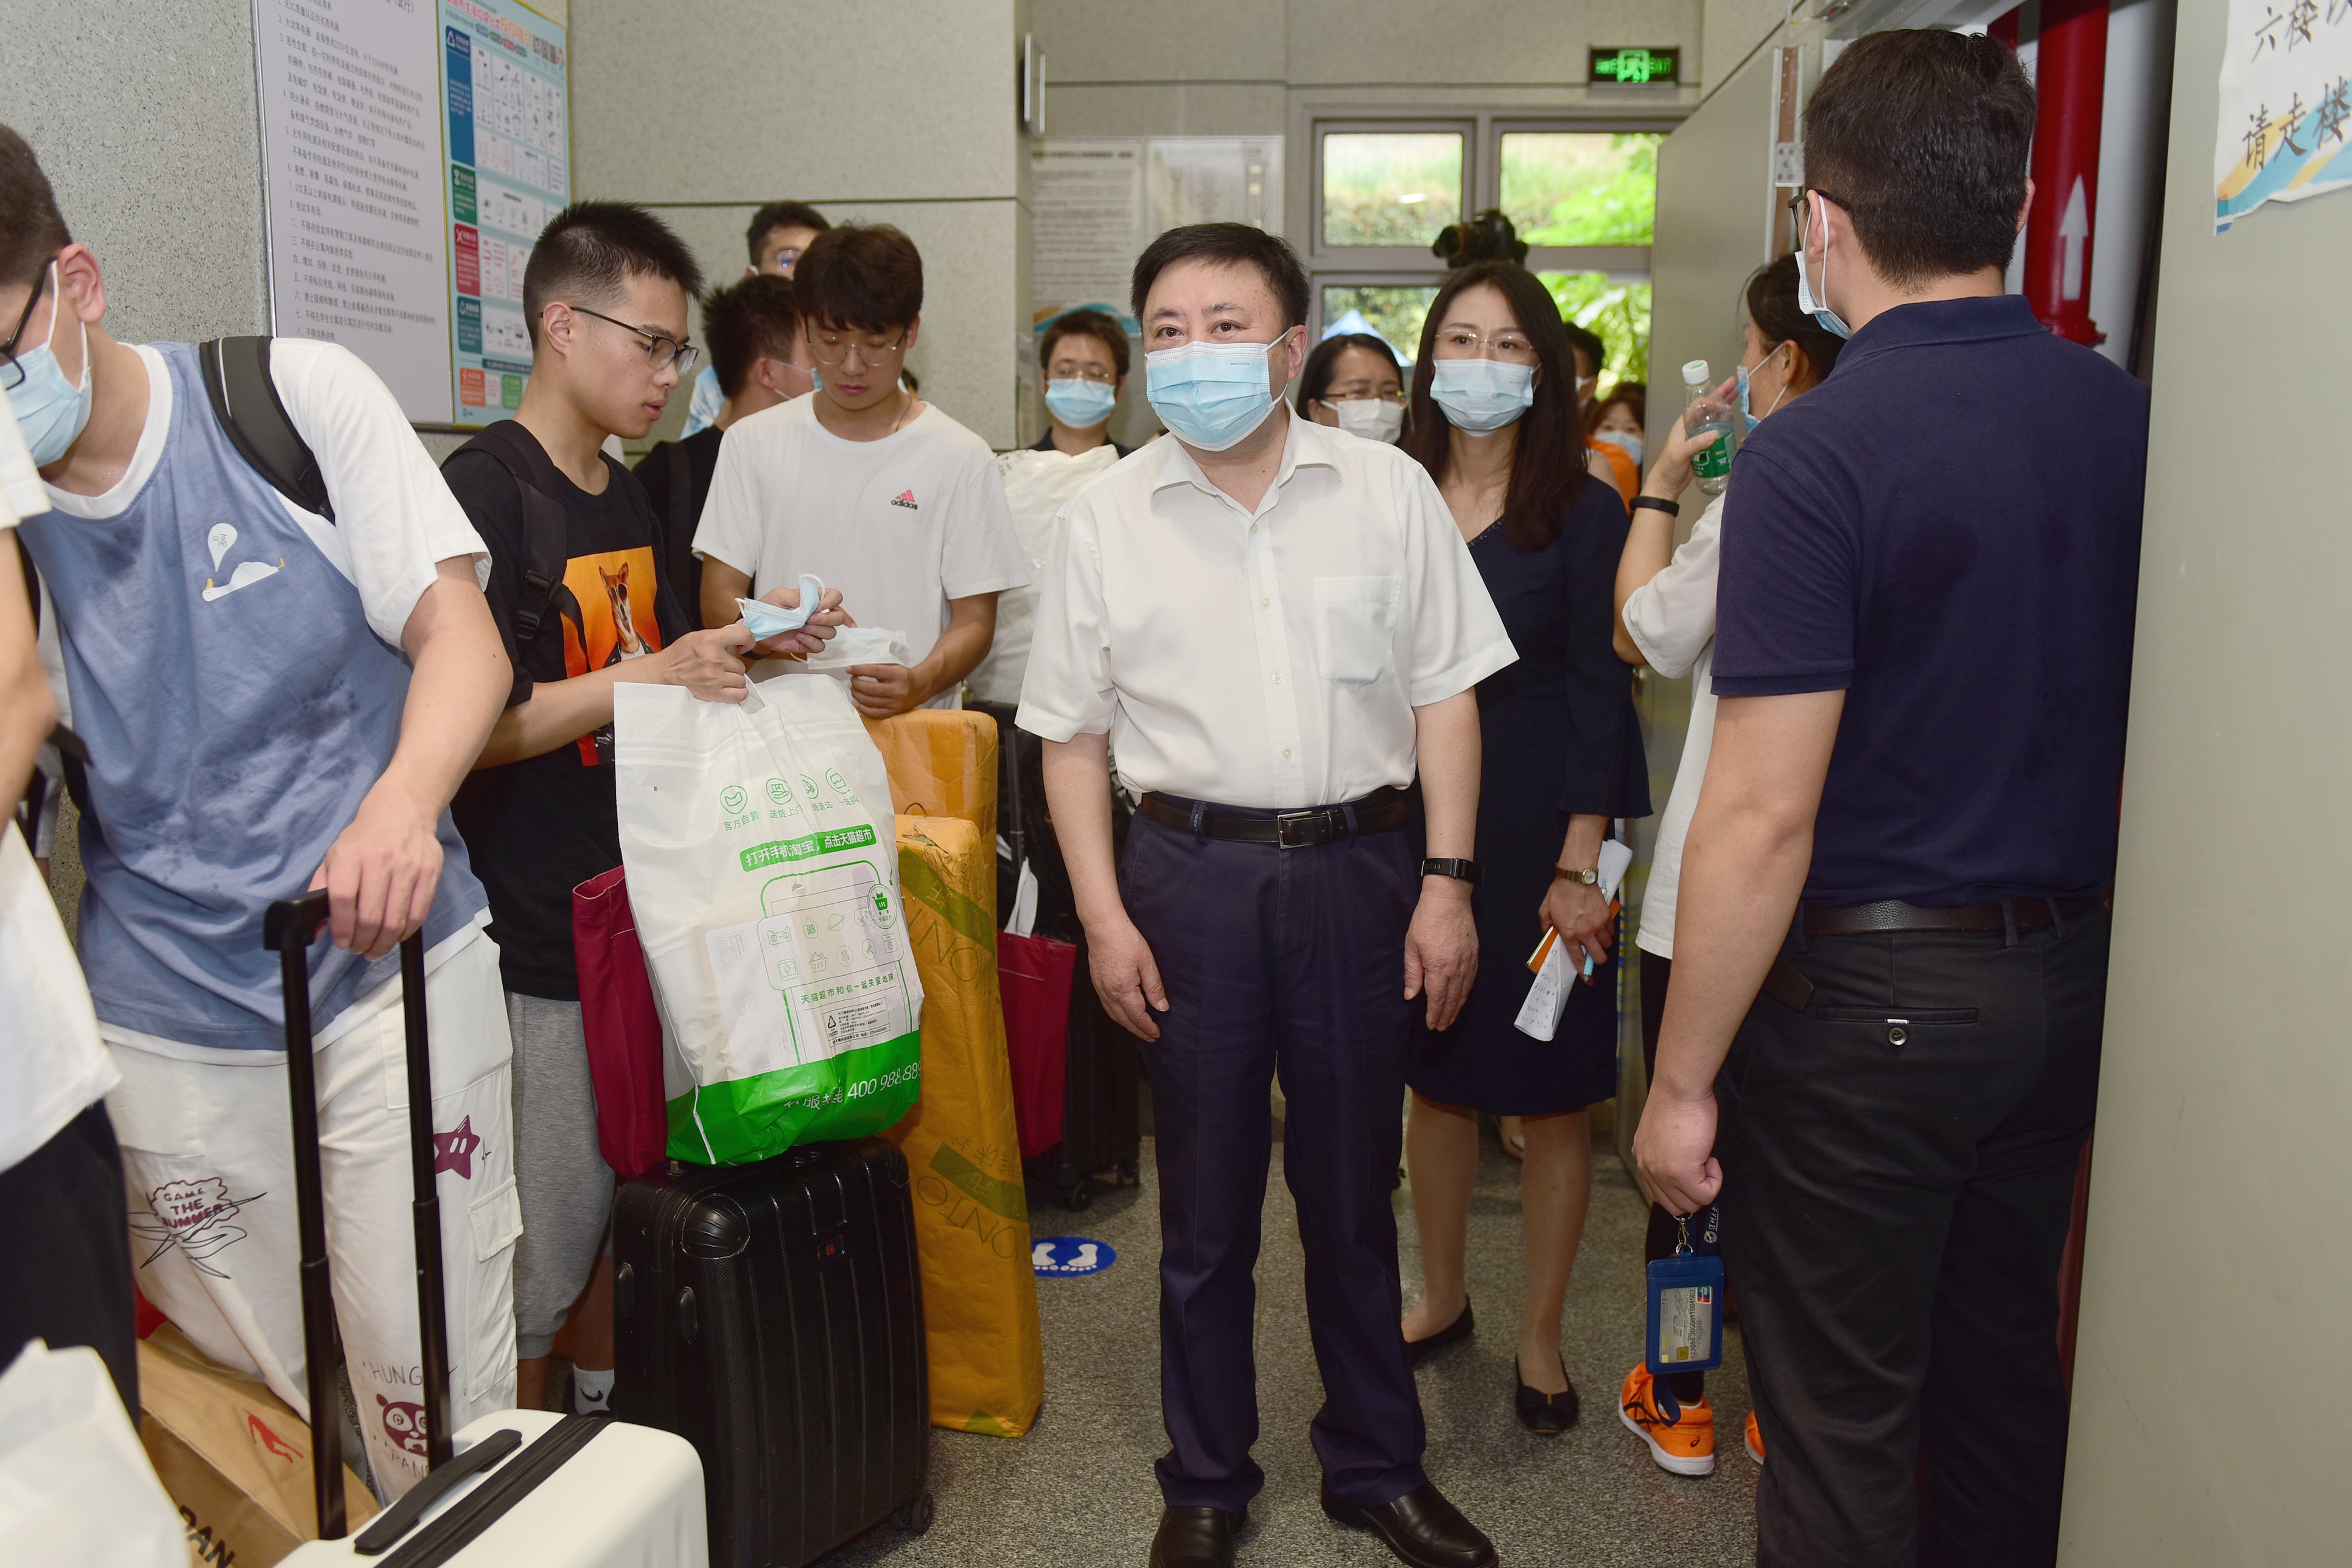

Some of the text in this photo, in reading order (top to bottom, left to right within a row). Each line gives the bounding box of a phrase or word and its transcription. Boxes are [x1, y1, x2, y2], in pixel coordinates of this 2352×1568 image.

[891, 499, 918, 510] adidas
[724, 810, 760, 831] 官方自营
[769, 804, 803, 819] 送货上门
[811, 800, 833, 811] 速送达
[878, 914, 892, 923] 天猫超市
[800, 972, 895, 1004] 天猫超市和你一起关爱地球
[847, 1078, 877, 1099] 400
[164, 1188, 205, 1202] GAME
[170, 1198, 205, 1216] THE
[368, 1361, 423, 1386] HUNG
